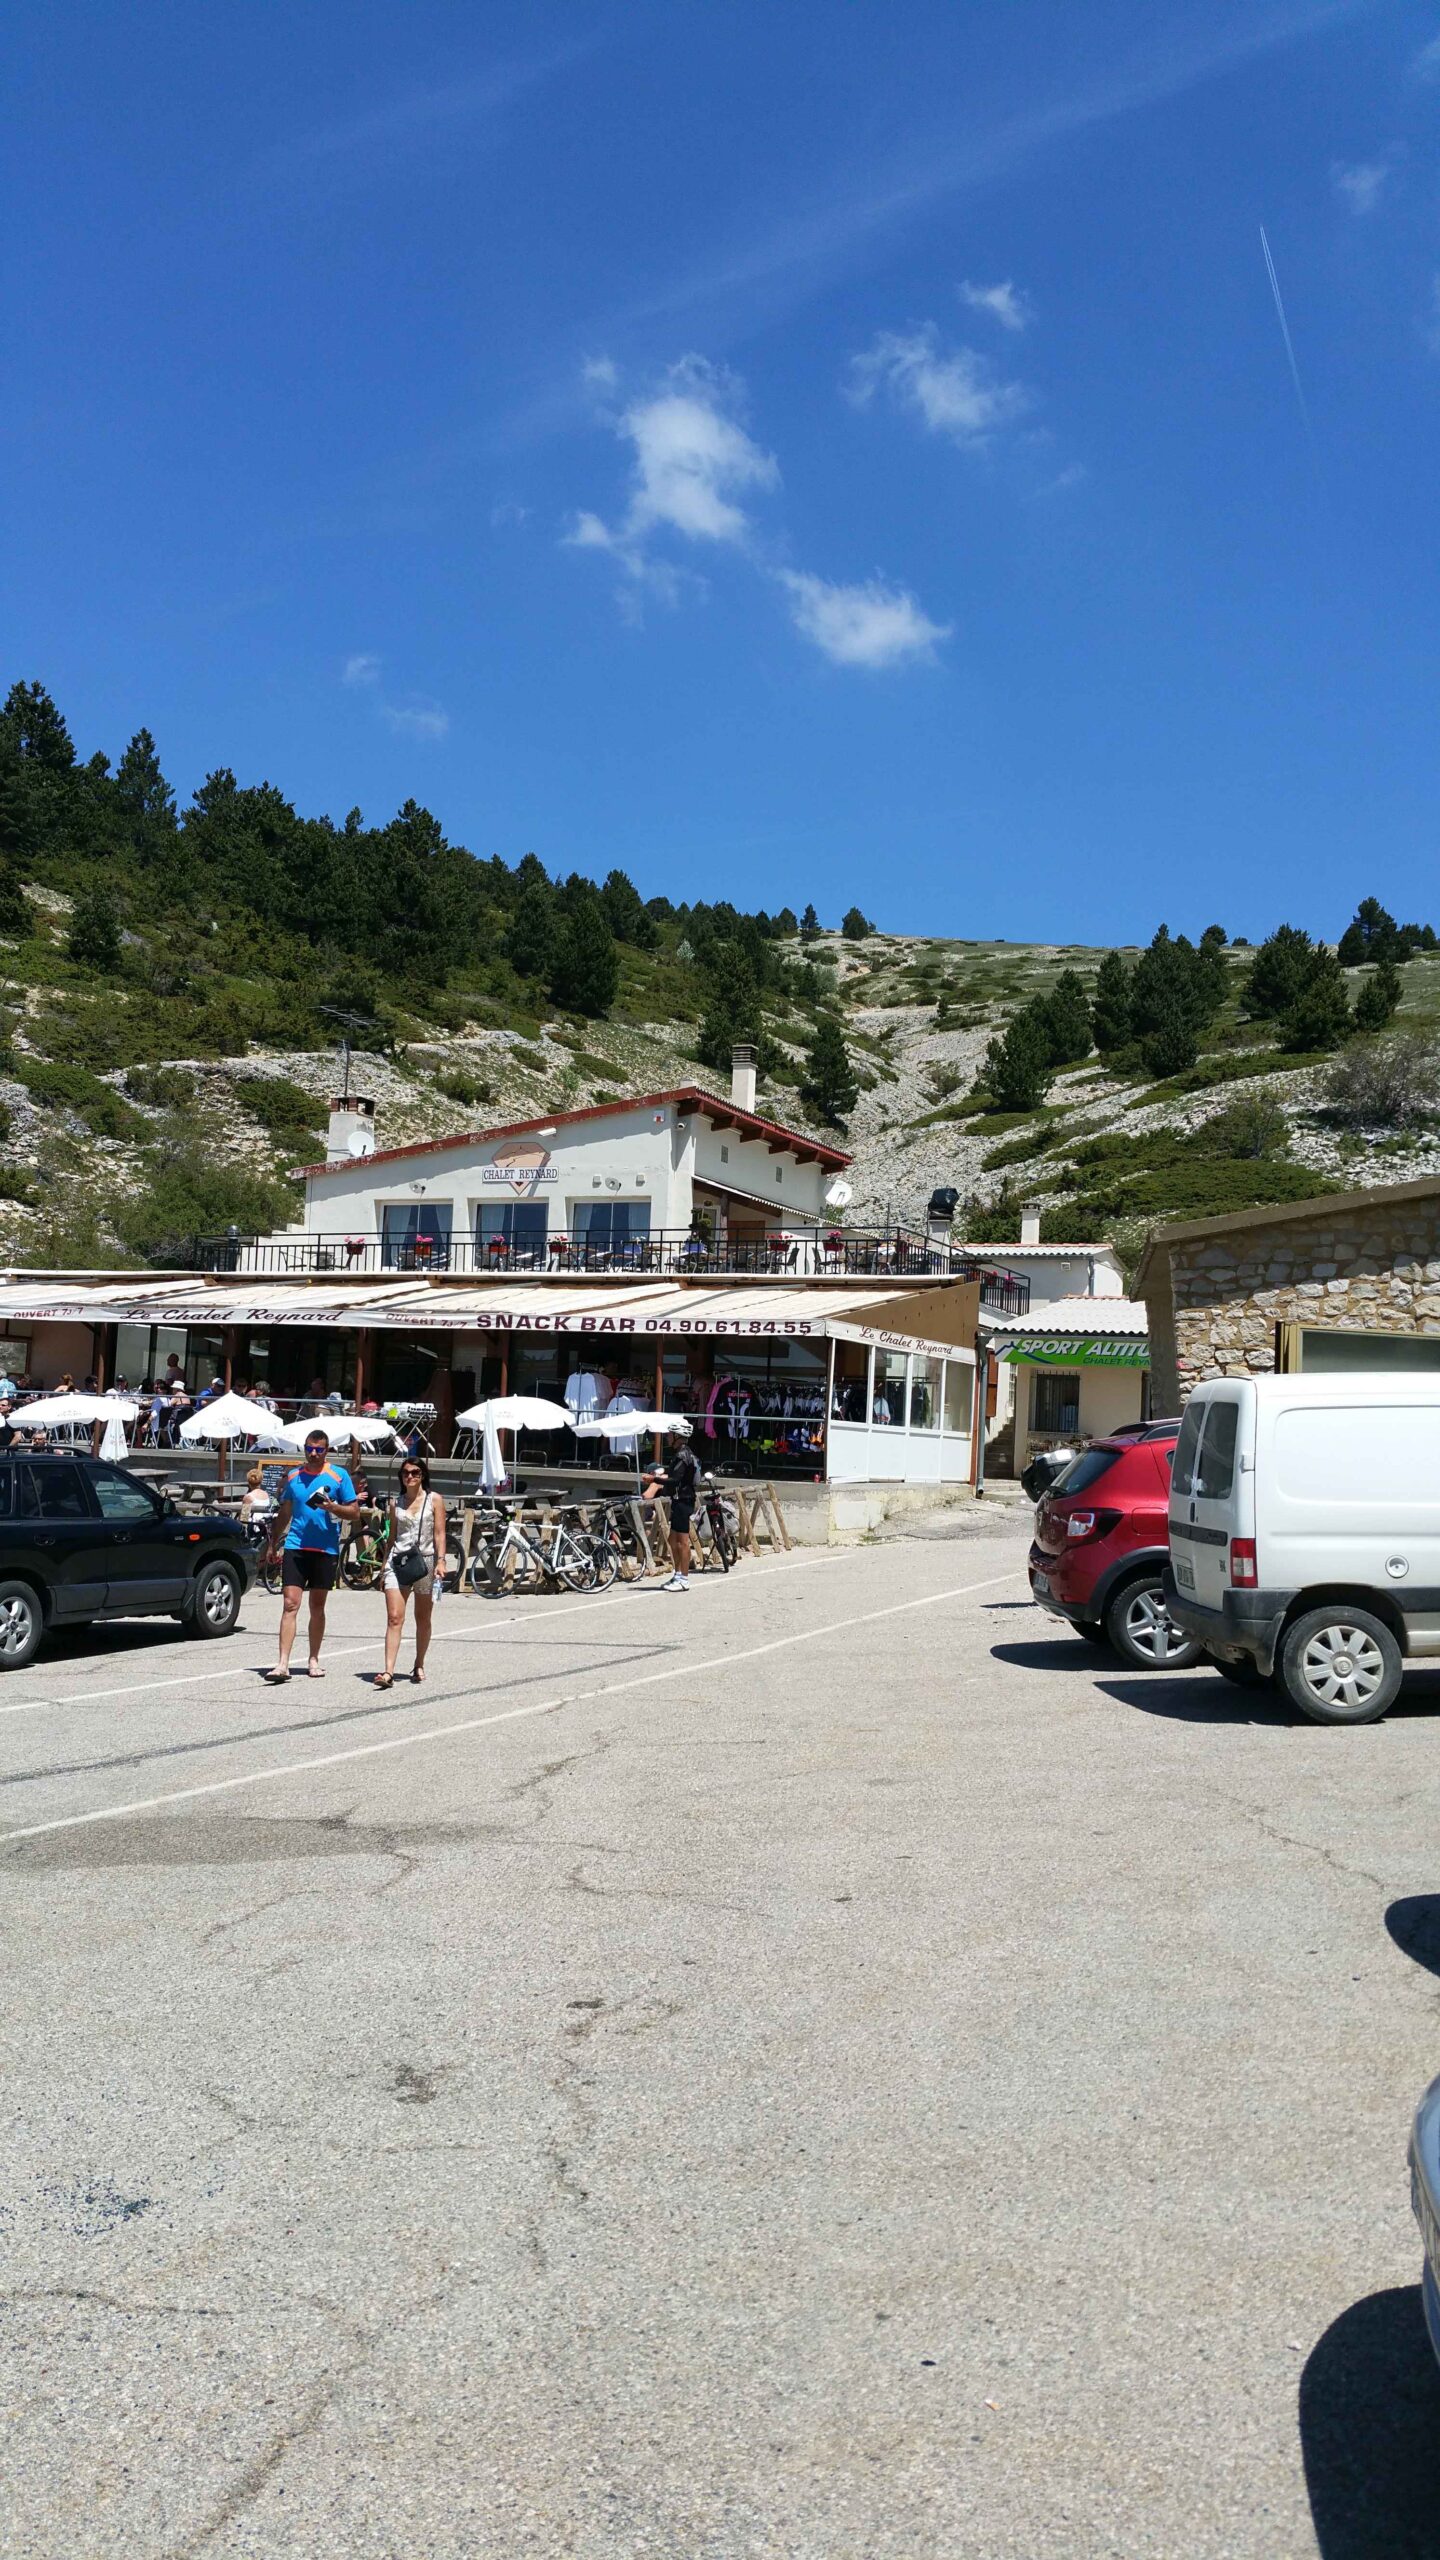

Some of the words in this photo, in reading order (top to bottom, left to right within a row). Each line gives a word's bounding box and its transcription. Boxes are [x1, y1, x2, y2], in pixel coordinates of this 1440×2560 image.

[483, 1169, 515, 1180] CHALET
[519, 1168, 558, 1179] REYNARD
[13, 1308, 58, 1319] OUVERT
[120, 1308, 151, 1321] Le
[162, 1308, 235, 1321] Chalet
[246, 1308, 344, 1324] Reynard
[386, 1312, 437, 1326] OUVERT
[477, 1314, 572, 1331] SNACK
[580, 1317, 636, 1332] BAR
[645, 1319, 813, 1335] 04.90.61.84.55
[859, 1326, 875, 1340] Le
[879, 1331, 912, 1348] Chalet
[915, 1339, 953, 1355] Reynard
[1018, 1339, 1085, 1356] SPORT
[1083, 1357, 1121, 1366] CHALET
